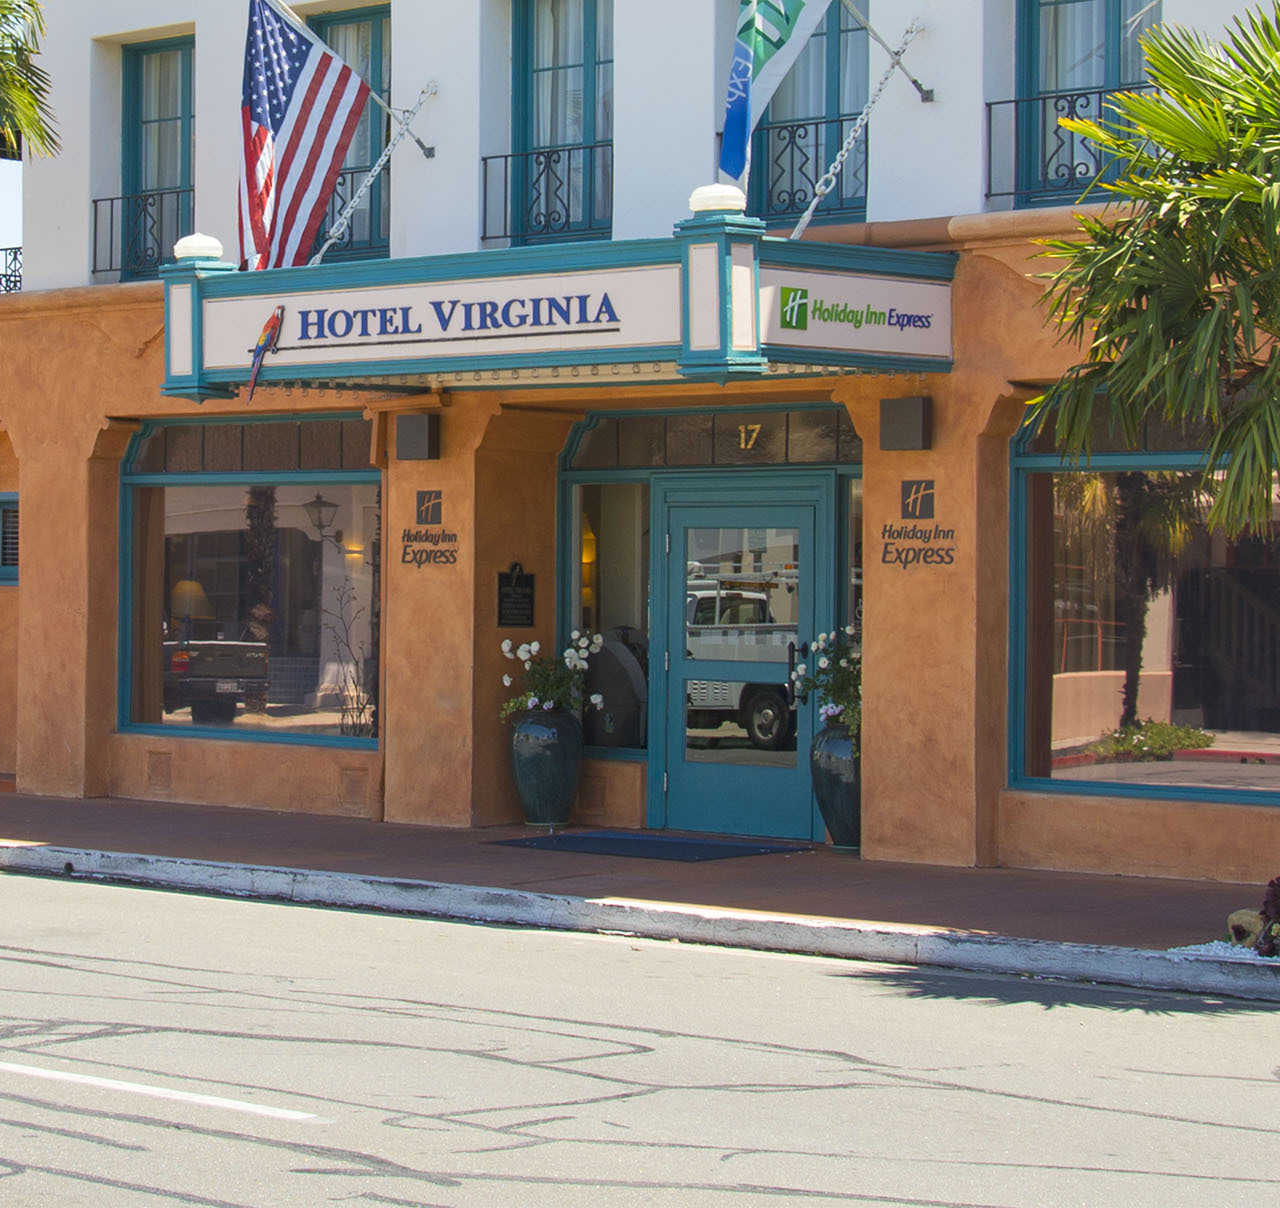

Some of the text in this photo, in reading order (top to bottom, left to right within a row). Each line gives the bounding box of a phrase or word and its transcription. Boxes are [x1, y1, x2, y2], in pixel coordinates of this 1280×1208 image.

[297, 292, 621, 341] HOTEL VIRGINIA
[811, 299, 864, 329] Holiday
[865, 304, 887, 326] Inn
[887, 307, 932, 331] Express
[737, 424, 762, 449] 17
[401, 528, 458, 546] Holiday Inn
[881, 523, 956, 544] Holiday Inn
[400, 544, 459, 569] Express
[880, 541, 956, 570] Express
